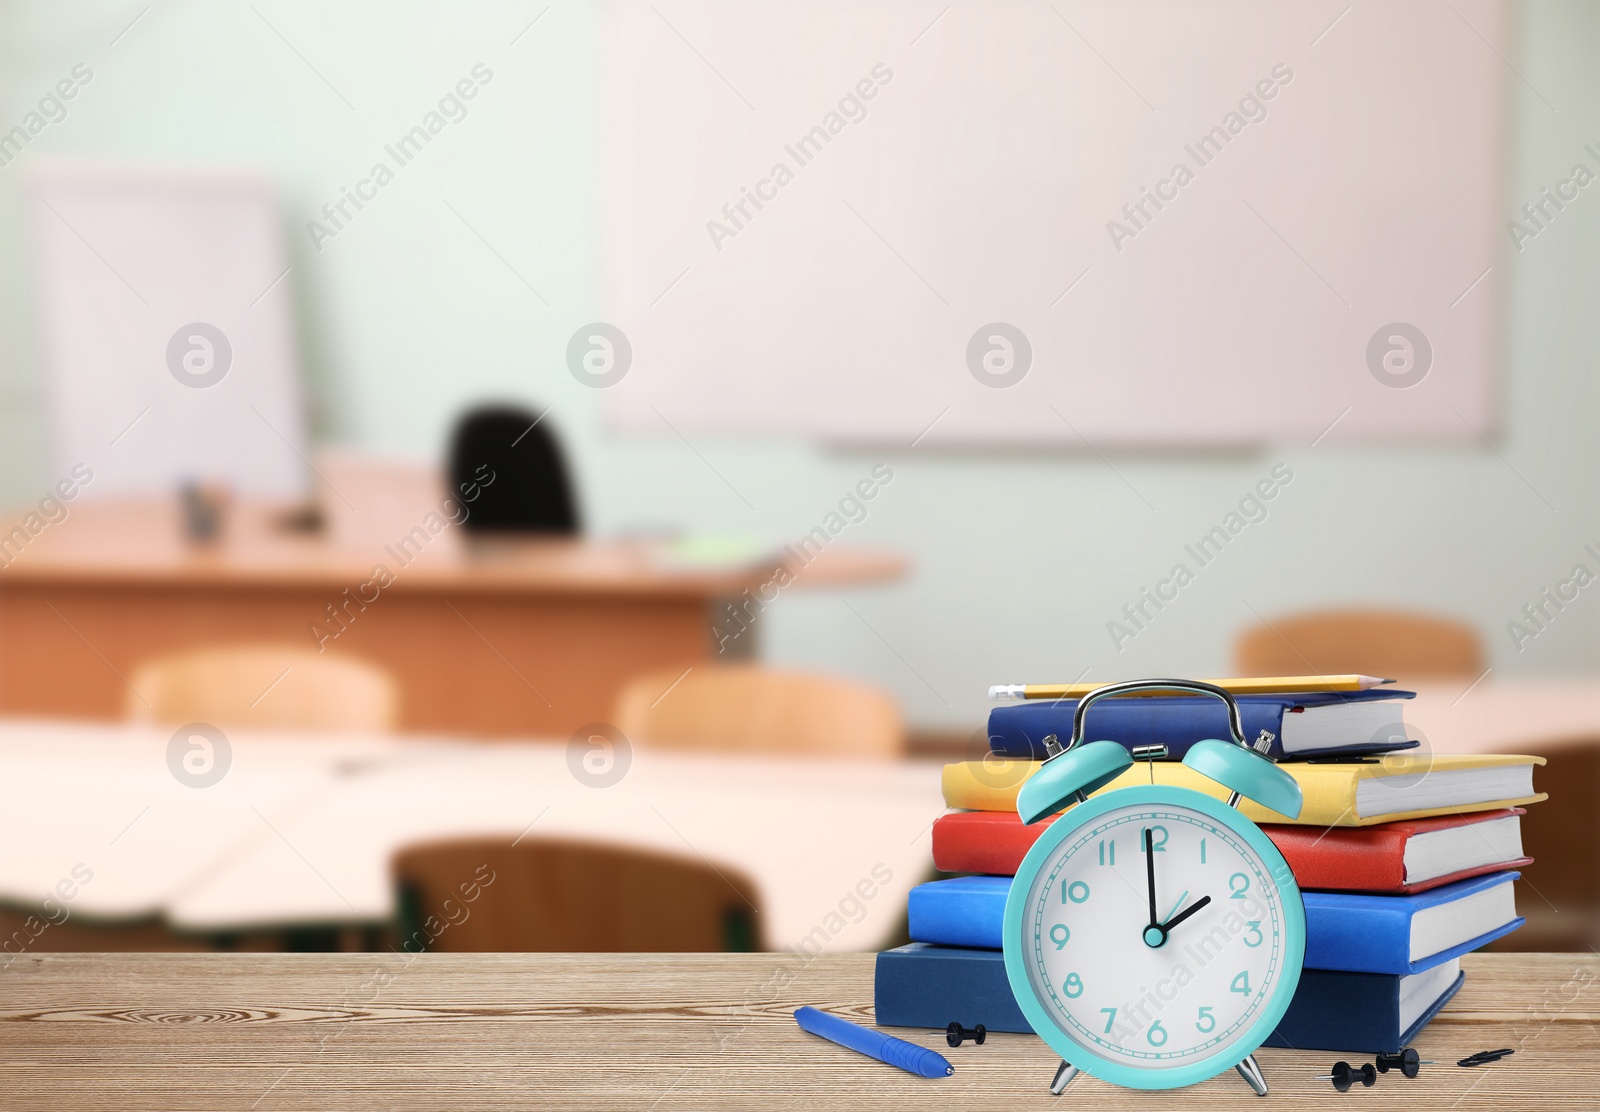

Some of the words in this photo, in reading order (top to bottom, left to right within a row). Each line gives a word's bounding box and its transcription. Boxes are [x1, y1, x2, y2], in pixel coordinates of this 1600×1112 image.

[1141, 825, 1169, 852] 12
[1200, 837, 1206, 864] 1
[1099, 839, 1115, 866] 11
[1061, 877, 1090, 905] 10
[1229, 872, 1250, 899] 2
[1049, 923, 1071, 951] 9
[1243, 921, 1263, 948] 3
[1062, 972, 1084, 999] 8
[1229, 970, 1252, 997] 4
[1100, 1007, 1118, 1034] 7
[1146, 1019, 1168, 1047] 6
[1195, 1006, 1216, 1033] 5
